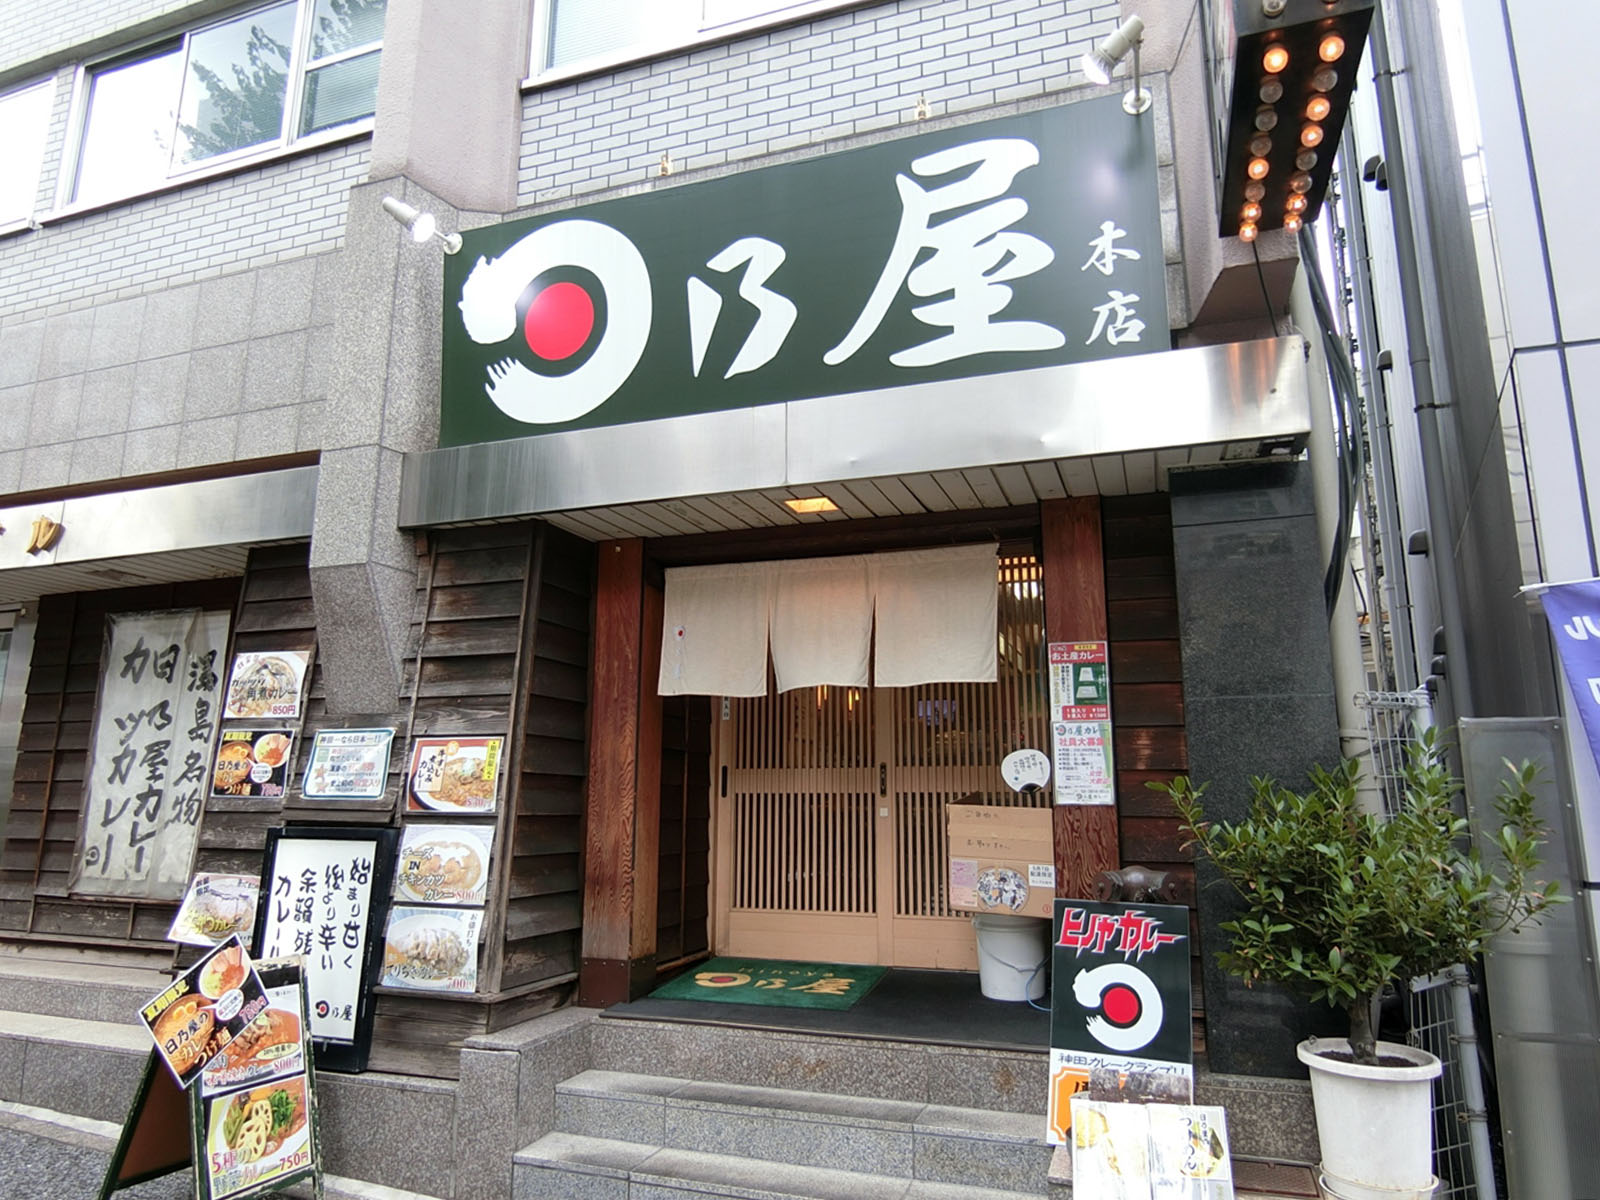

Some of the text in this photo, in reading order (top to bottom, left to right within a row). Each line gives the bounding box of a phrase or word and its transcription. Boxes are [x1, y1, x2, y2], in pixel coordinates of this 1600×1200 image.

[1081, 220, 1146, 346] 本店
[1052, 651, 1104, 661] お土産カレー
[272, 704, 296, 715] 850円
[165, 649, 219, 826] 湯島名物
[417, 760, 428, 789] カレー
[402, 847, 434, 860] チーズ
[408, 861, 421, 871] IN
[399, 873, 446, 886] チキンカツ
[423, 889, 456, 902] カレー
[318, 863, 345, 970] 後より辛い
[343, 857, 371, 969] 始まり甘く
[164, 1011, 209, 1055] 日乃屋の
[193, 1028, 233, 1068] つけ麺
[212, 1147, 252, 1174] 5種の
[279, 1151, 309, 1171] 750円
